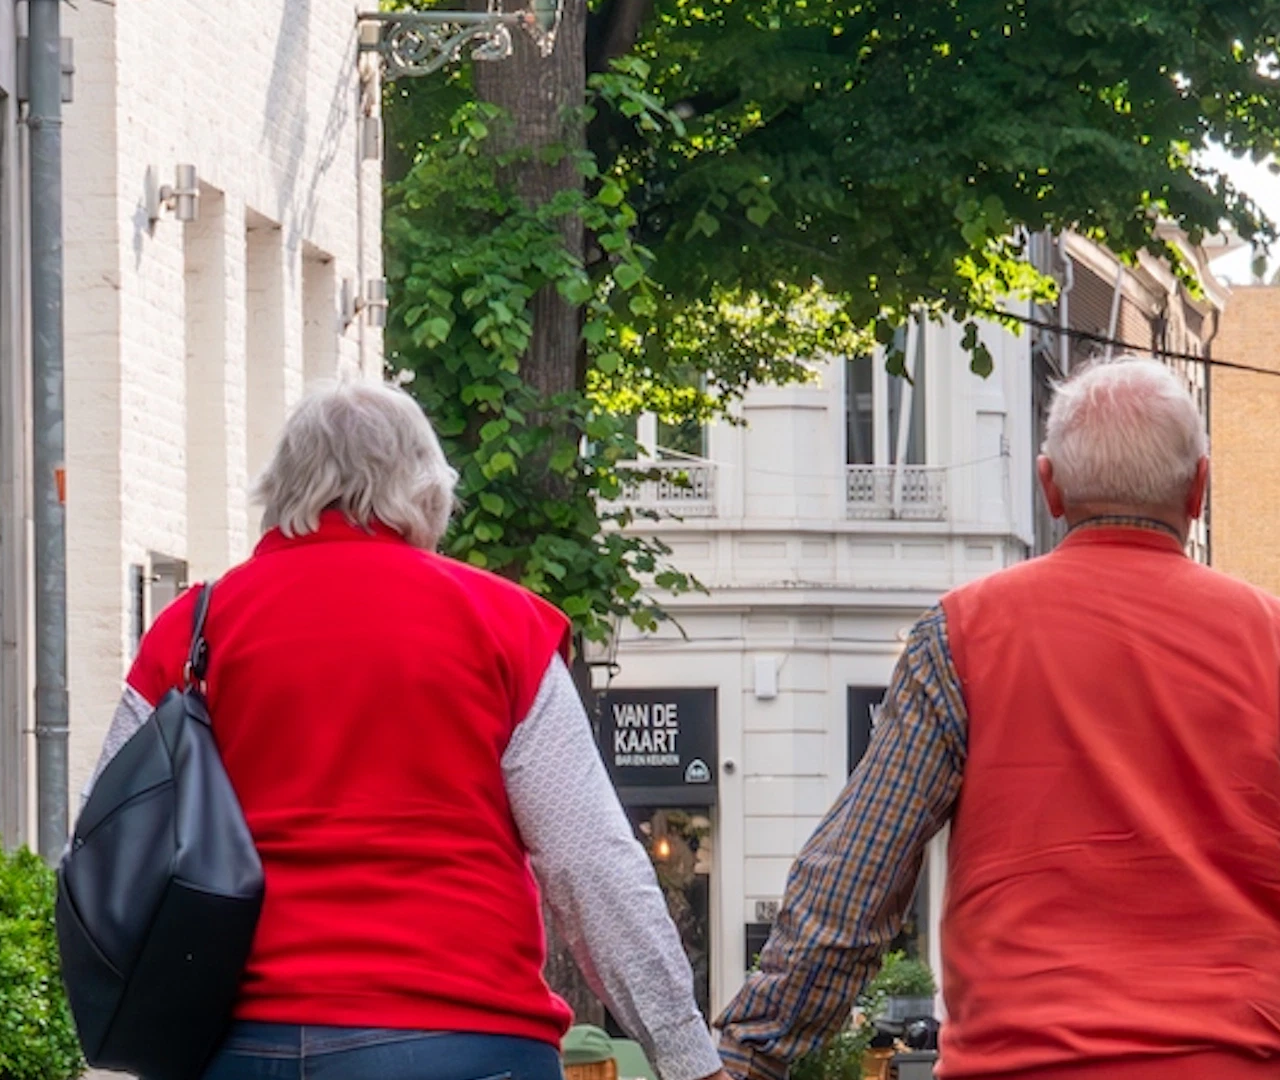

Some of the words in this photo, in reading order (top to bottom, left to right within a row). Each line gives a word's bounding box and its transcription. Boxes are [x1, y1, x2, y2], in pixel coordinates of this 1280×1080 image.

[613, 703, 649, 727] VAN
[652, 703, 678, 727] DE
[614, 729, 679, 752] KAART
